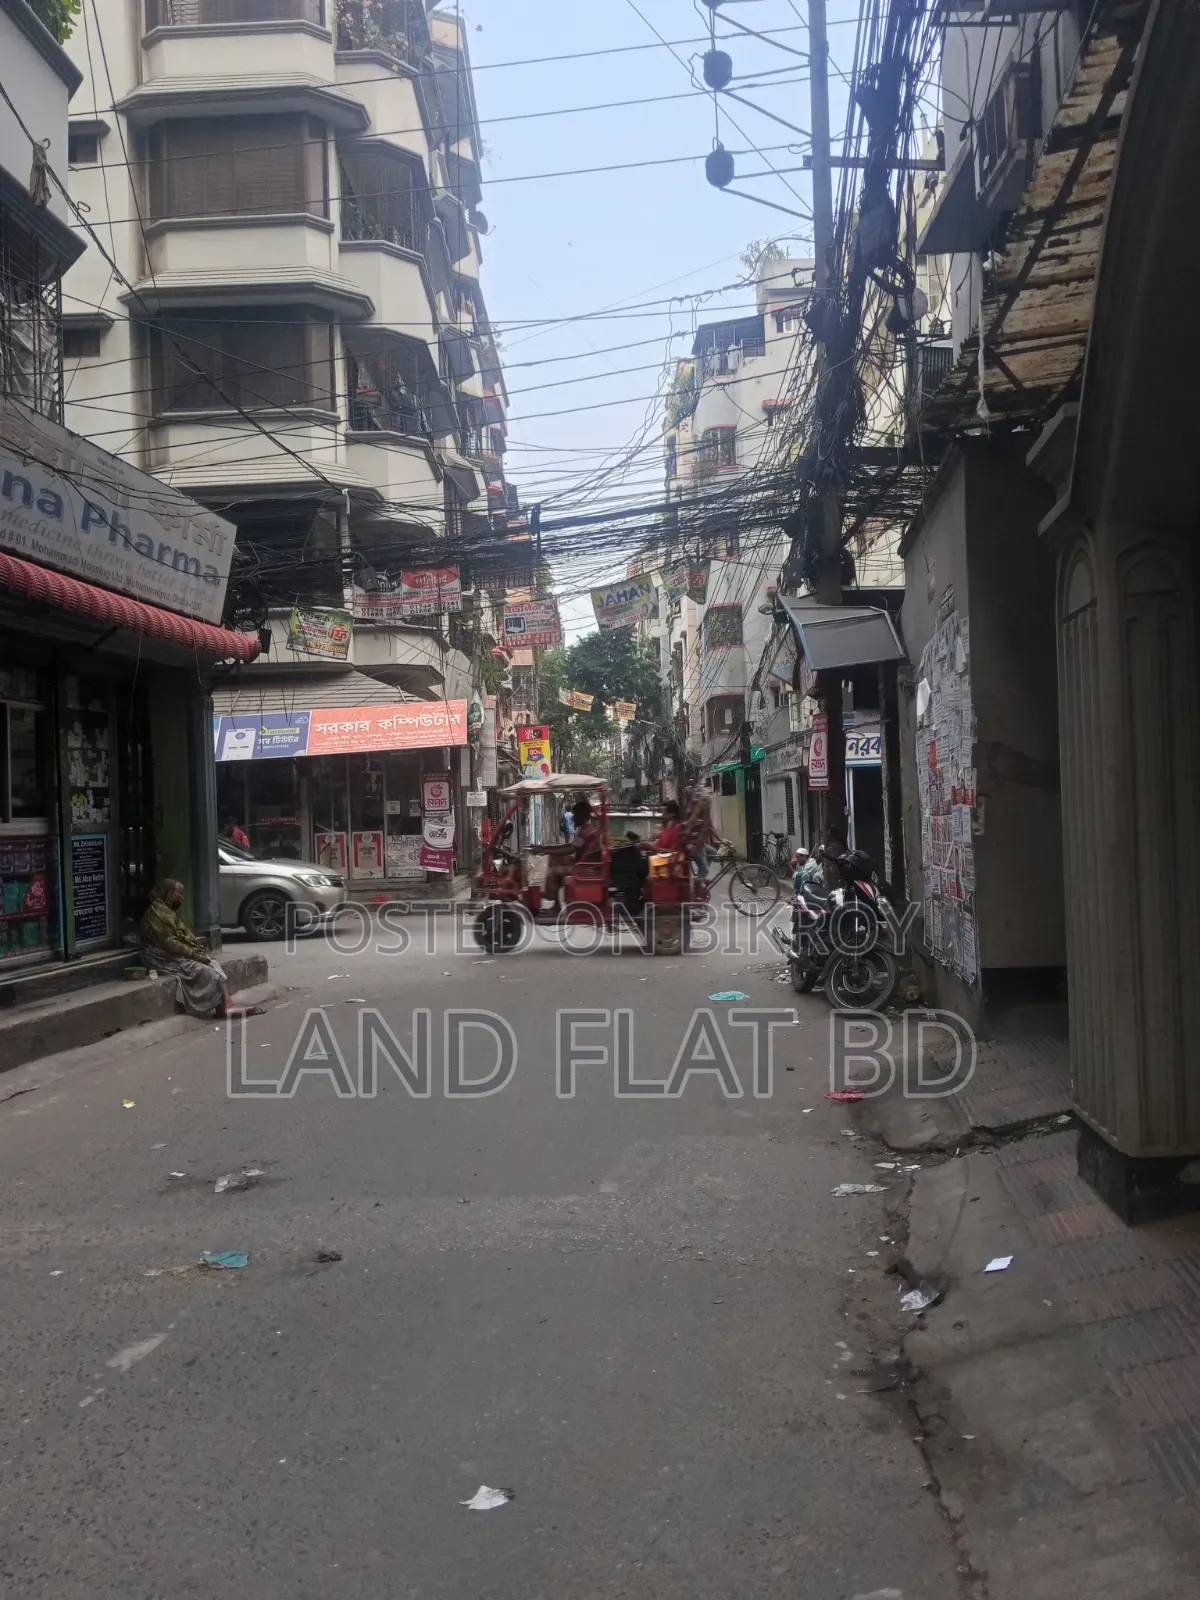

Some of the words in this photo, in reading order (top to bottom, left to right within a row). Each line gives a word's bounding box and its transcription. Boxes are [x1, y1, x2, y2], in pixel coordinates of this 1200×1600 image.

[81, 500, 220, 586] Pharma
[80, 557, 111, 581] Housing
[596, 583, 651, 609] JAHAN
[312, 719, 372, 735] সরকার
[377, 712, 463, 731] কম্পিউটার
[811, 758, 826, 770] নগদ
[427, 798, 447, 808] নগদ
